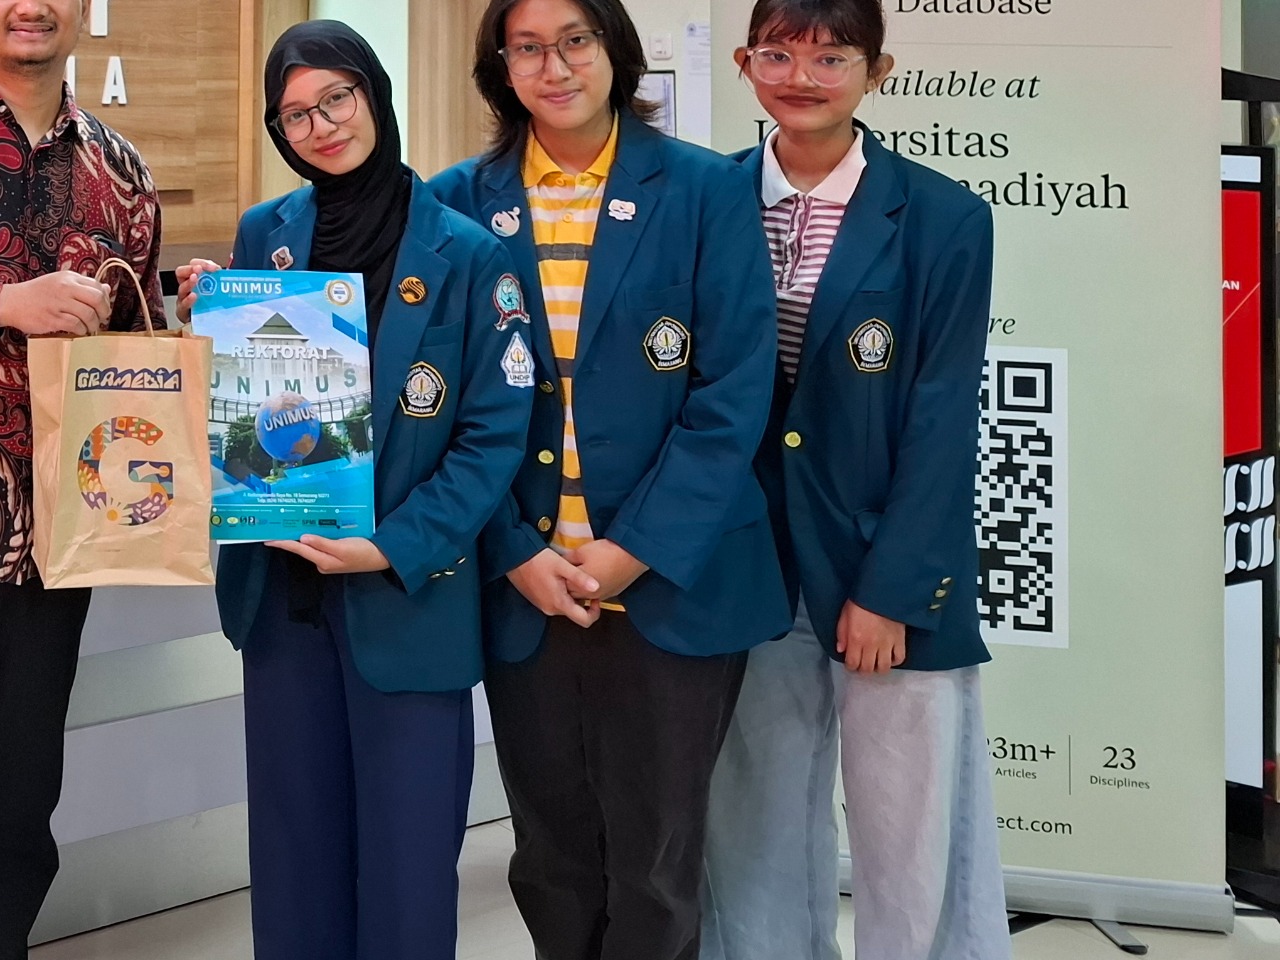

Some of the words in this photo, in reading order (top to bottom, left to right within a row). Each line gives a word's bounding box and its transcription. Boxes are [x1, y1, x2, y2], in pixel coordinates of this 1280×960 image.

[101, 55, 128, 105] A
[880, 70, 996, 97] ailable
[1005, 74, 1041, 98] at
[221, 282, 282, 294] UNIMUS
[231, 344, 331, 360] REKTORAT
[76, 368, 180, 389] GRAMEDIA
[264, 407, 317, 431] UNIMUS
[987, 737, 1056, 762] 3m+
[1102, 746, 1137, 770] 23
[995, 767, 1037, 780] Articles
[1089, 775, 1151, 789] Disciplines
